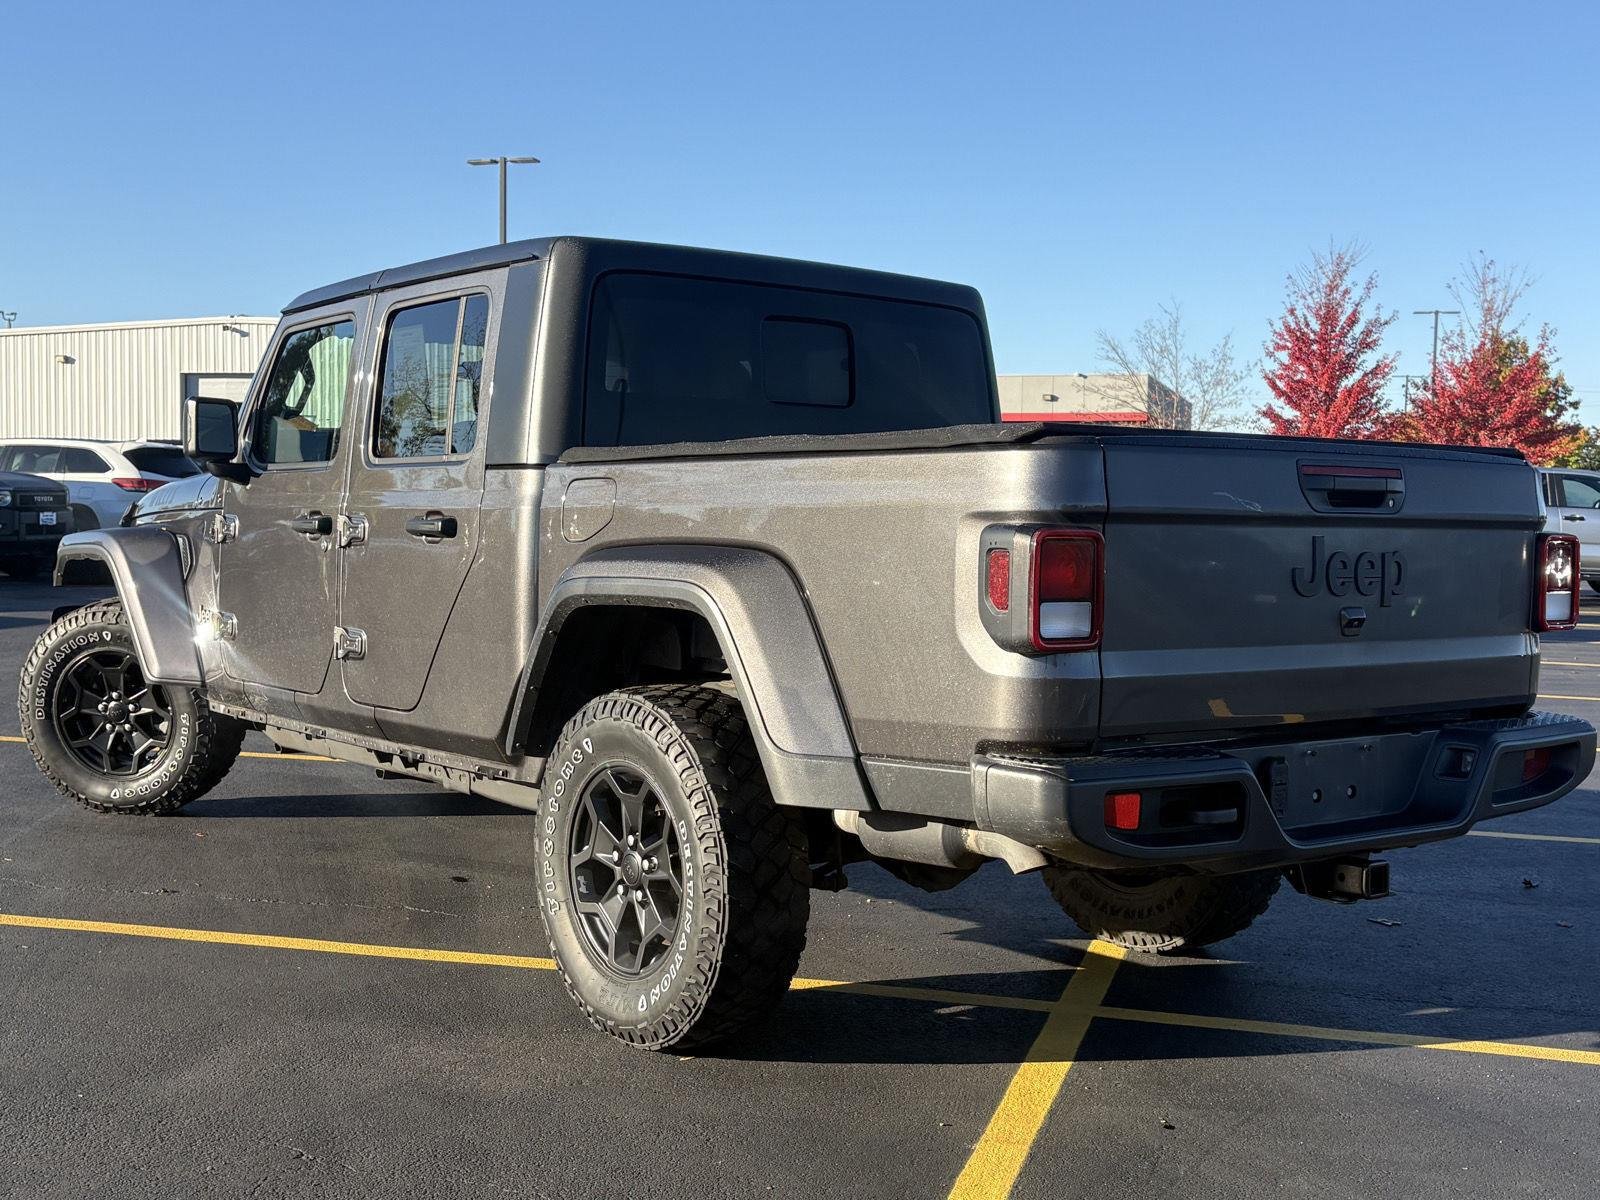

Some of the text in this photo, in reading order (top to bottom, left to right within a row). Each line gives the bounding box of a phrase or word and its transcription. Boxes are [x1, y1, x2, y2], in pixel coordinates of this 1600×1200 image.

[1291, 535, 1406, 607] Jeep
[35, 632, 100, 720] DESTINATION
[124, 713, 190, 798] Firestone
[543, 749, 583, 915] Firestone
[650, 820, 694, 1006] DESTINATION
